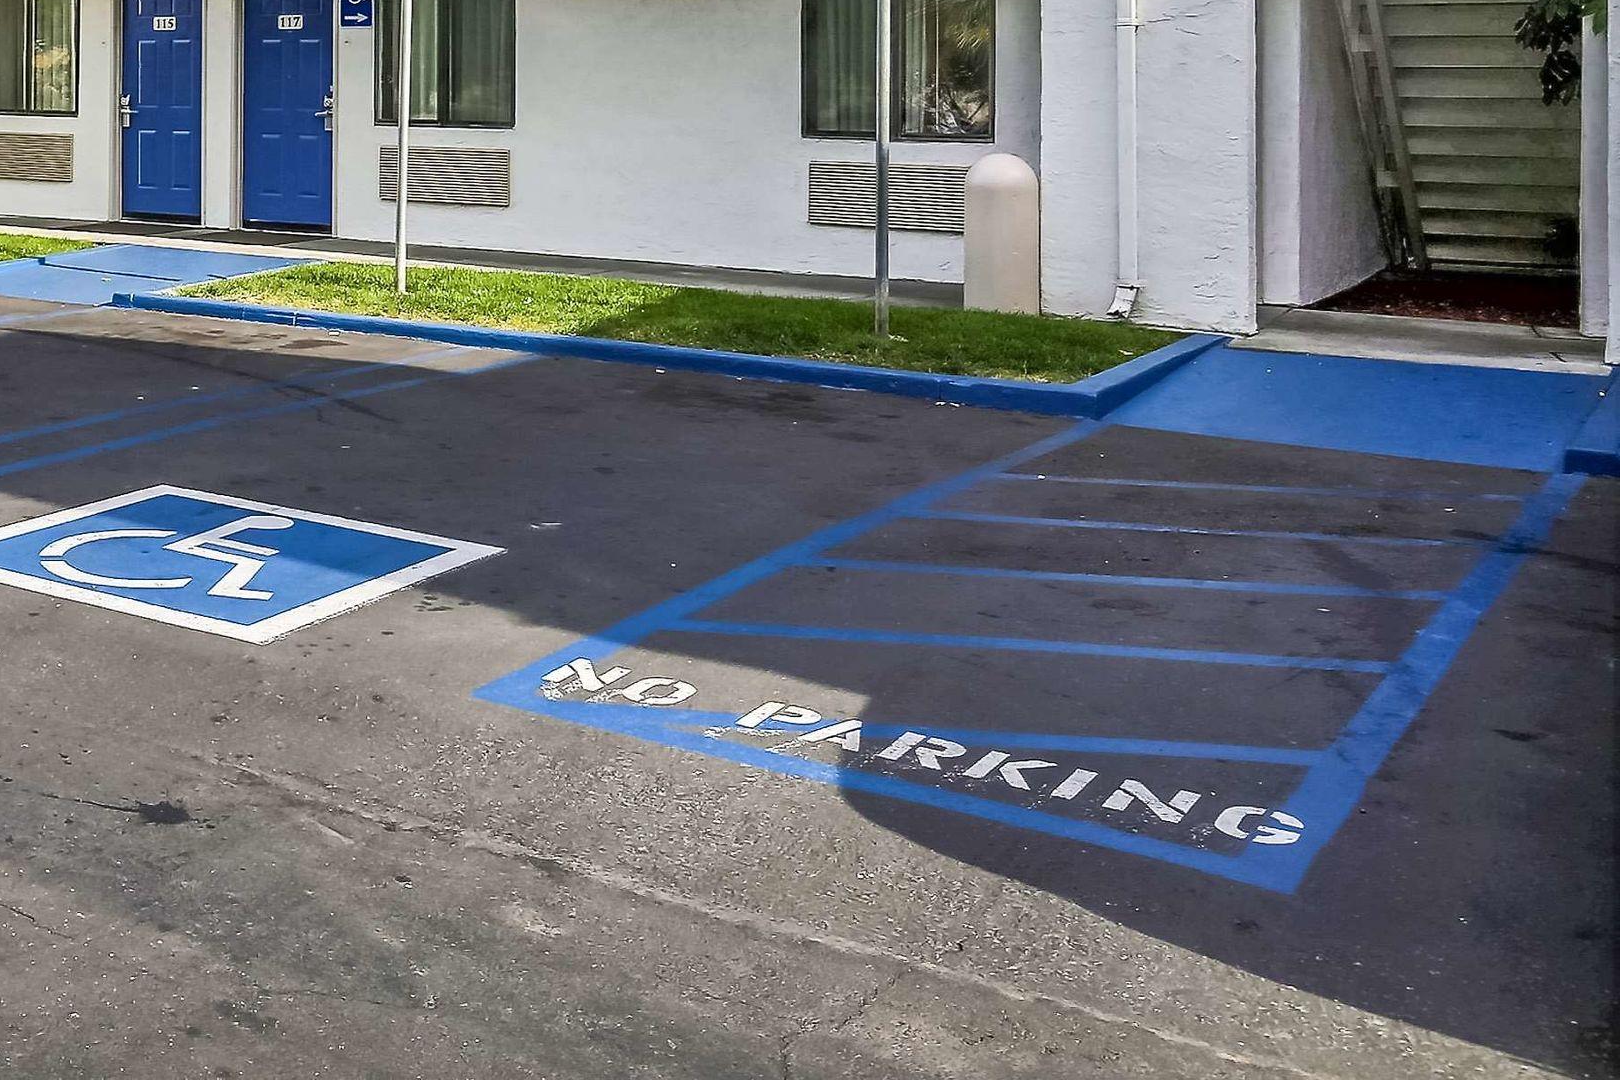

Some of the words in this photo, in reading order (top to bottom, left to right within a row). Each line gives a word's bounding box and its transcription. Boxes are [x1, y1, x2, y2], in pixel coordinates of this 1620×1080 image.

[156, 18, 175, 29] 115
[280, 16, 301, 27] 117
[541, 657, 698, 706] NO
[734, 700, 1306, 845] PARKING
